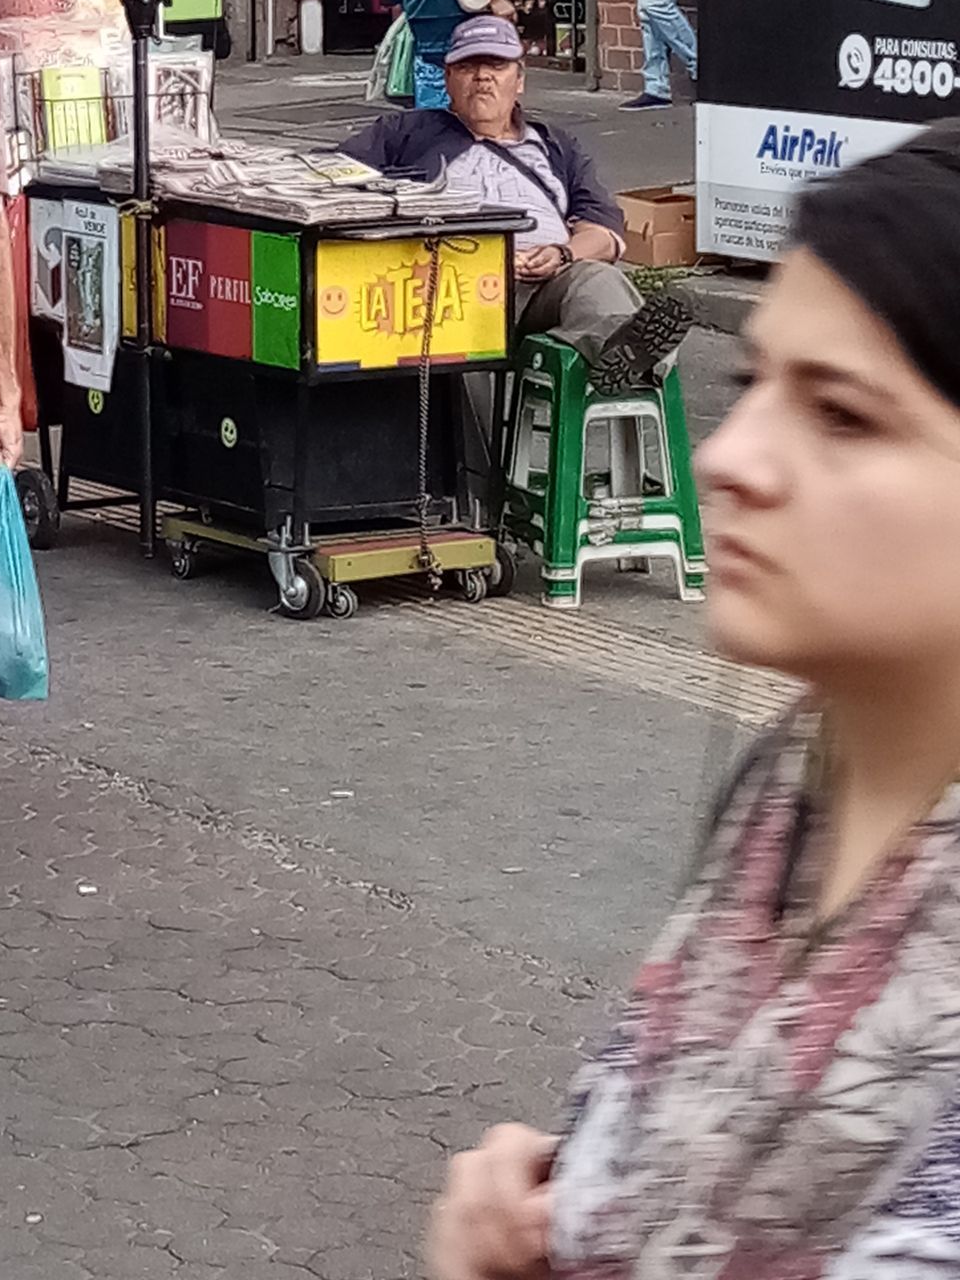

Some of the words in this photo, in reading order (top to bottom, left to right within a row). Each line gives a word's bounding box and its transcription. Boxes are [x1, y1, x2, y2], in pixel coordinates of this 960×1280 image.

[875, 37, 899, 55] PARA
[901, 39, 957, 60] CONSULTAS:
[756, 124, 842, 168] AirPak
[169, 256, 203, 300] EF
[209, 275, 252, 305] PERFIL
[361, 282, 388, 332] LA
